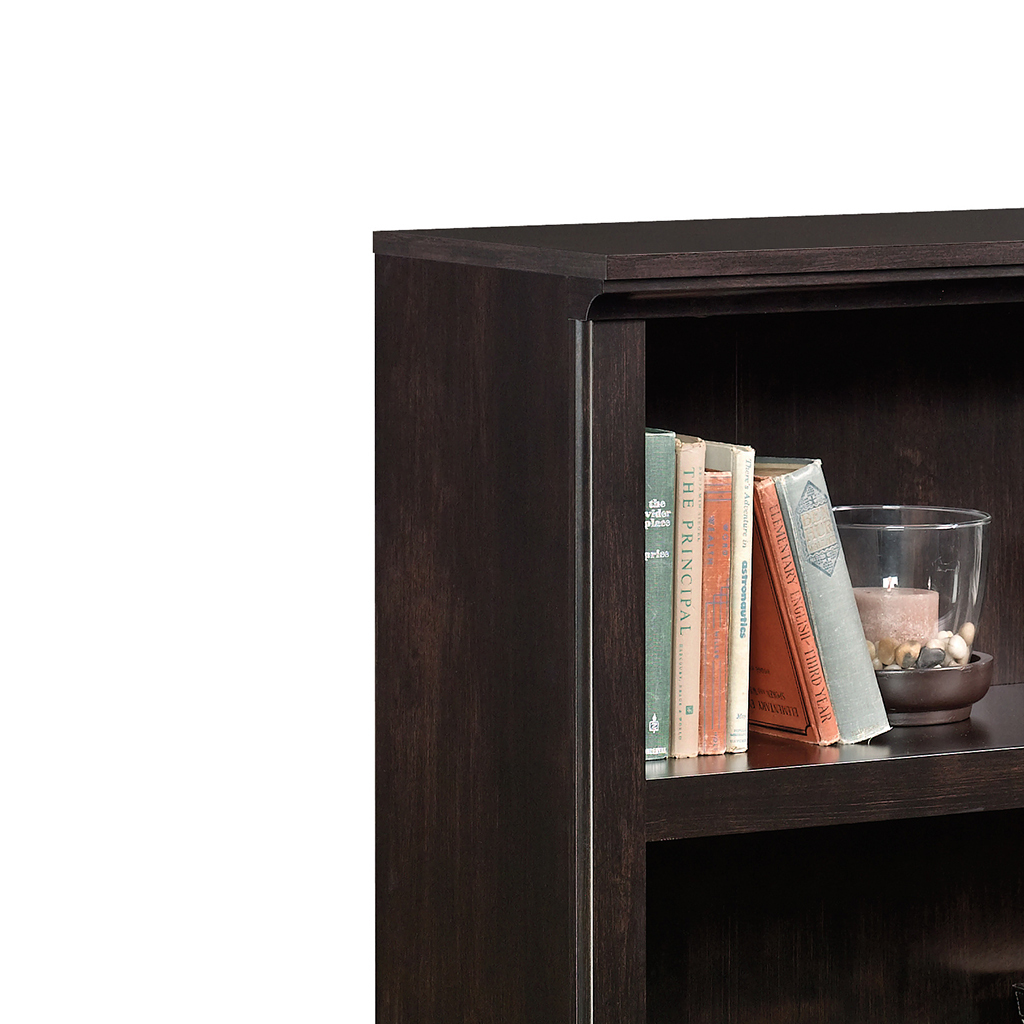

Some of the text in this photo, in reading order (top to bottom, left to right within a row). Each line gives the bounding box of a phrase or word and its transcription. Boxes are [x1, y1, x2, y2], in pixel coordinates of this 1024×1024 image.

[648, 498, 666, 509] the
[680, 467, 695, 636] THE PRINCIPAL
[707, 515, 715, 565] WEALTH
[740, 458, 752, 639] There's Adventure in astronautics
[769, 504, 797, 585] ELEMENTARY
[815, 687, 832, 723] YEAR
